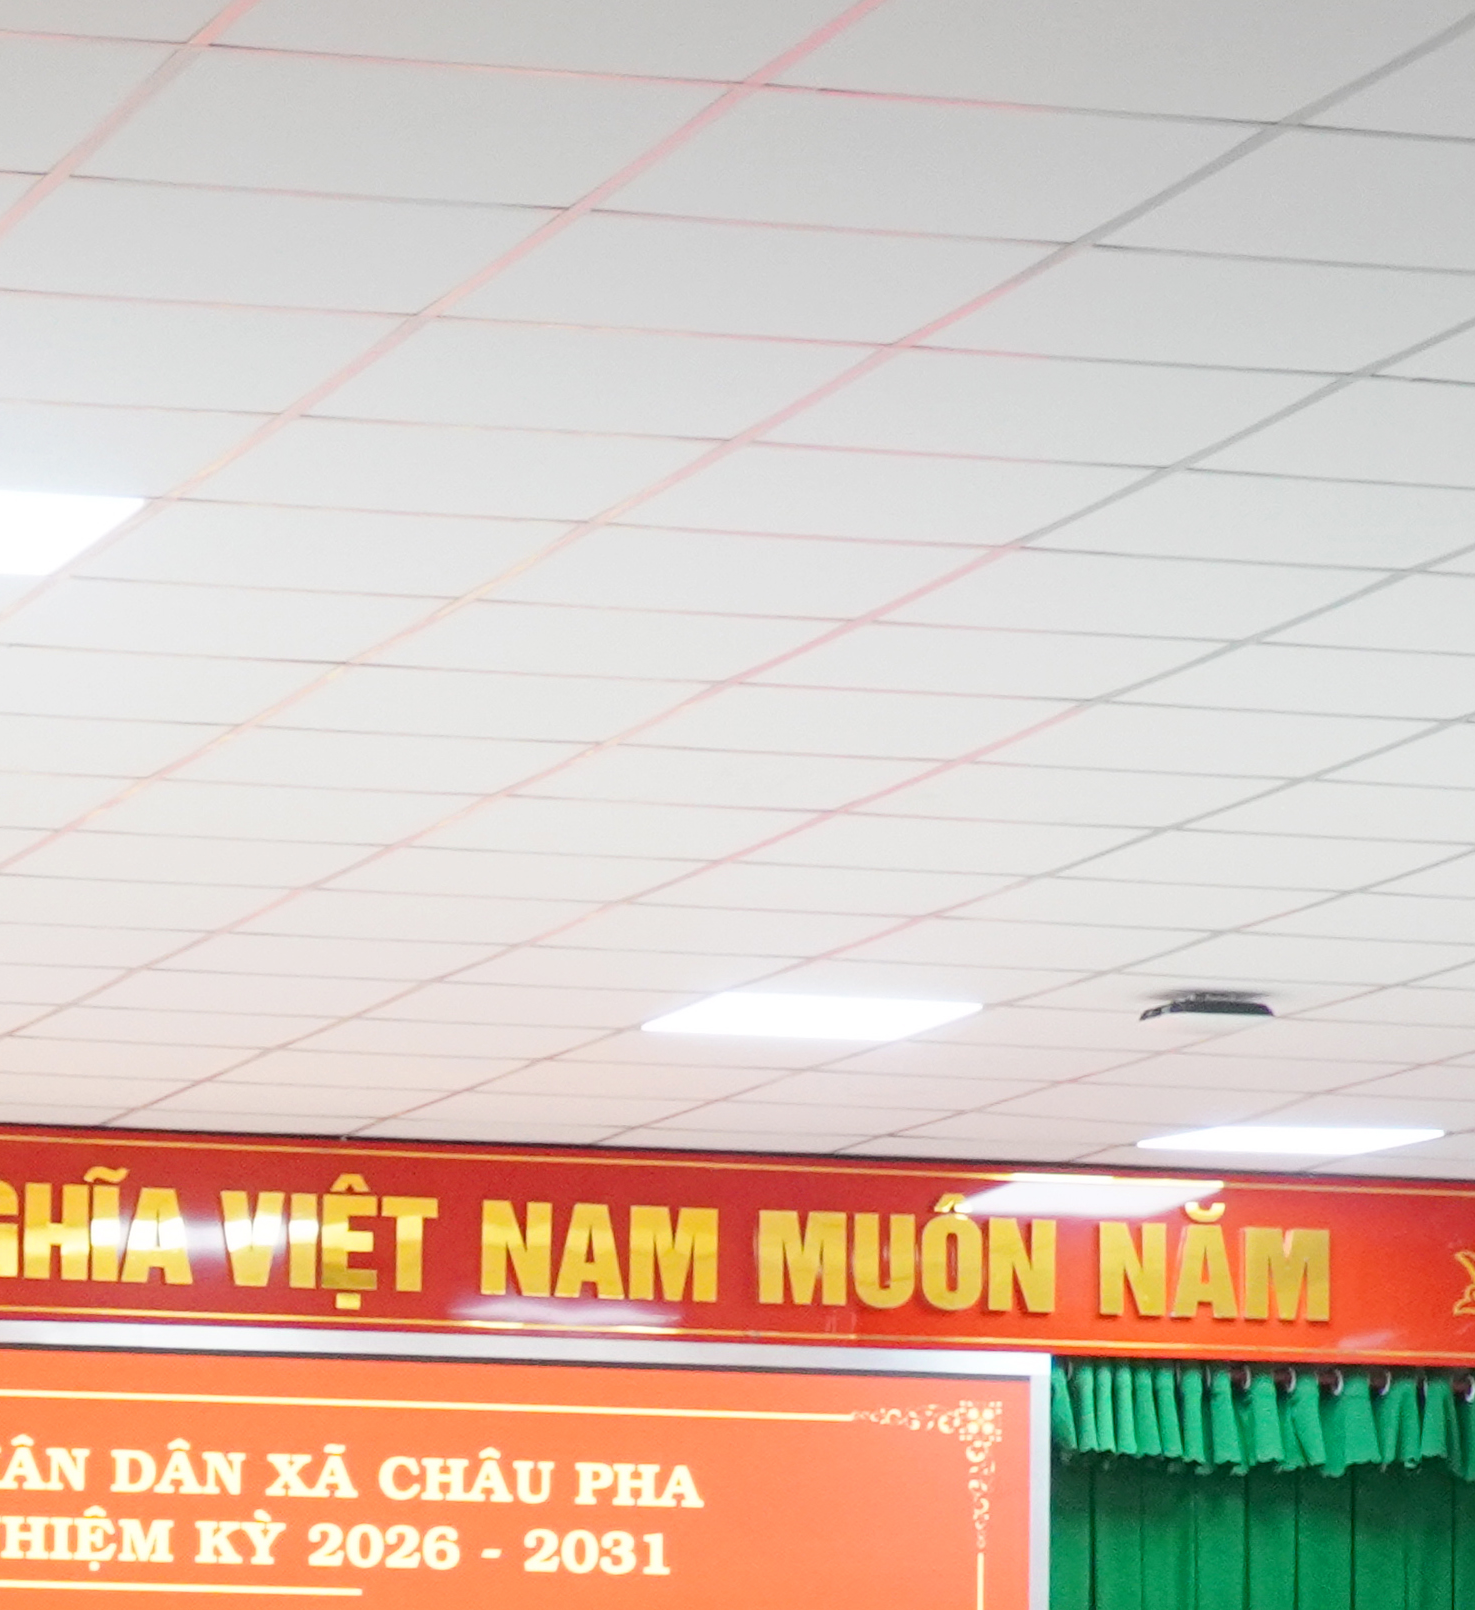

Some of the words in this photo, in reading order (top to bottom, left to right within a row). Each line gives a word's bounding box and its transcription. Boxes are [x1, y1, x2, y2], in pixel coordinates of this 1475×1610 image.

[220, 1173, 439, 1310] VIỆT
[479, 1198, 719, 1305] NAM
[756, 1193, 1057, 1315] MUÔN
[1098, 1201, 1330, 1323] NĂM
[110, 1439, 247, 1500] DÂN
[266, 1444, 358, 1502] XÃ
[379, 1447, 556, 1508] CHÂU
[576, 1463, 705, 1512] PHA
[193, 1508, 288, 1569] KỲ
[307, 1524, 461, 1573] 2026
[481, 1546, 502, 1558] -
[524, 1528, 672, 1578] 2031
